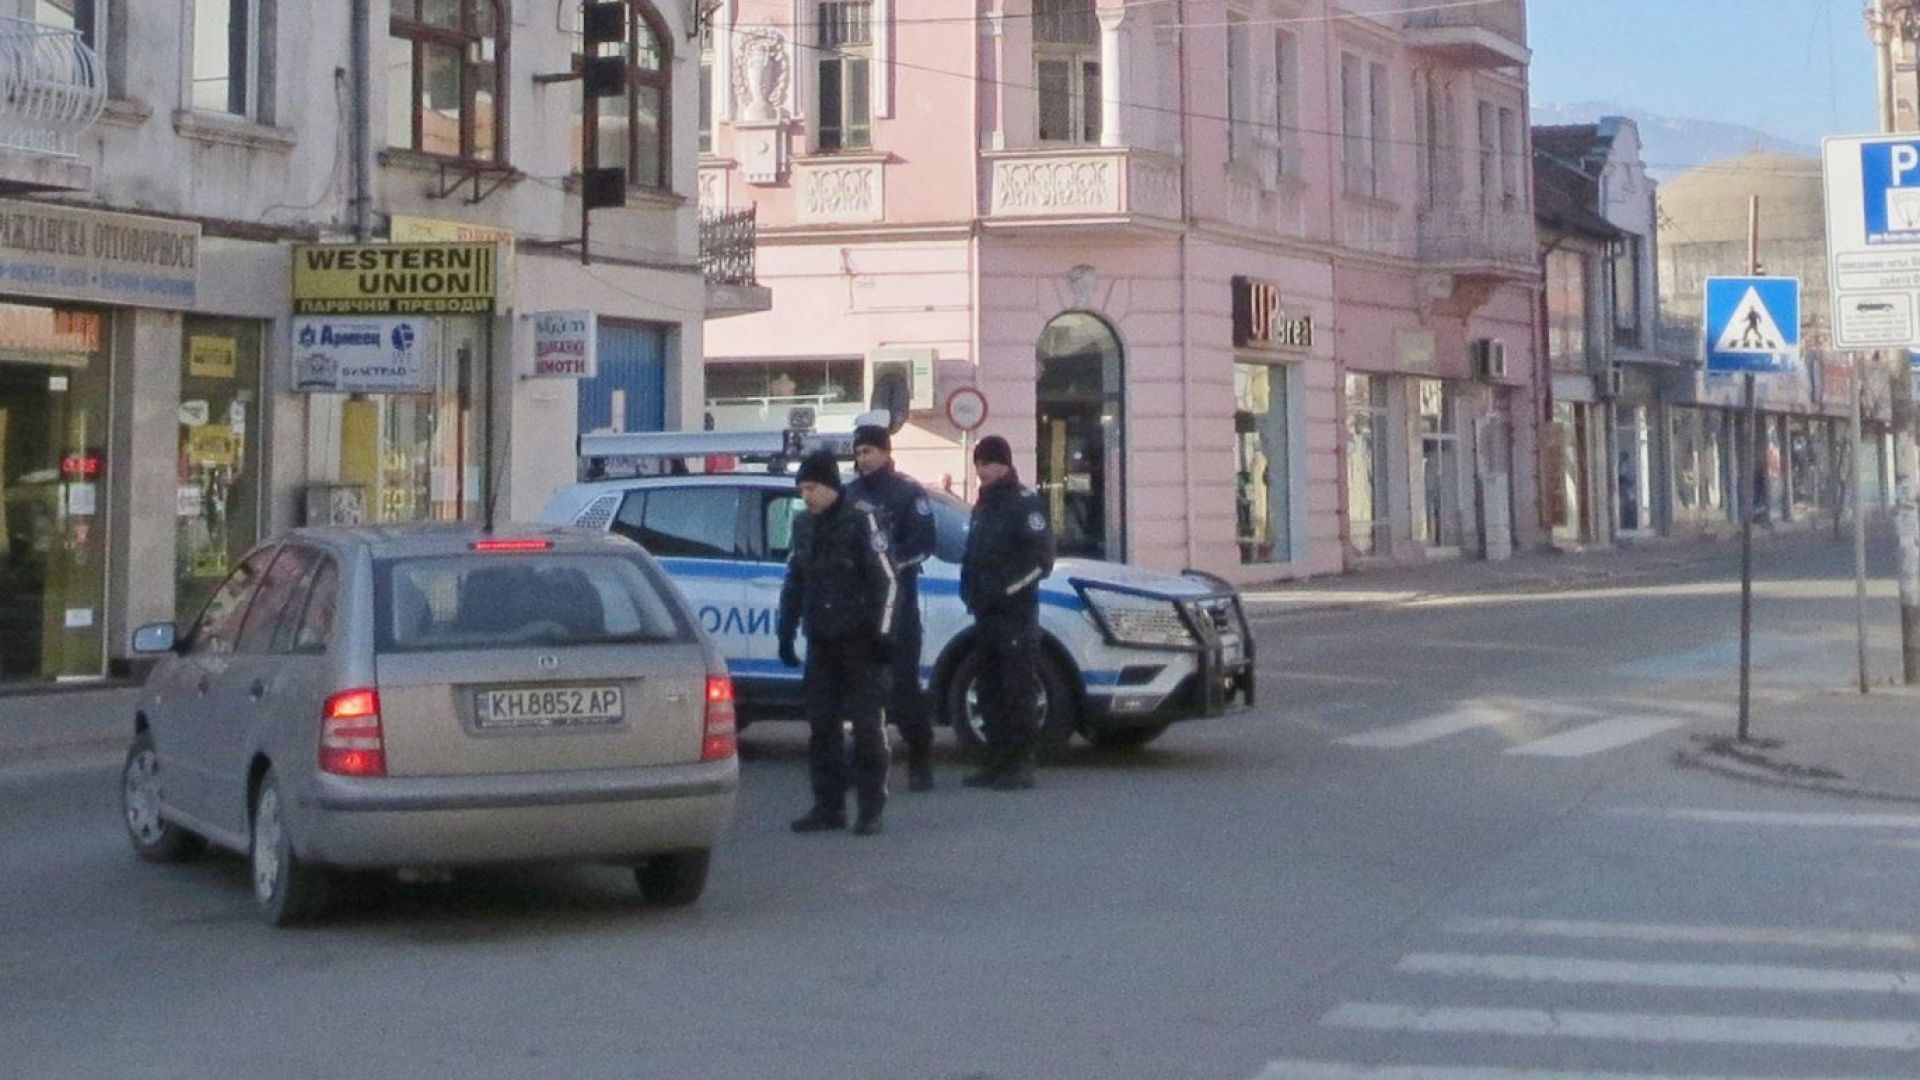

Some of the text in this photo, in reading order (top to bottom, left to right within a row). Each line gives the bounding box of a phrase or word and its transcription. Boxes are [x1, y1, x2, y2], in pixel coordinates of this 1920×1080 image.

[1890, 144, 1918, 186] P
[306, 248, 471, 270] WESTERN
[358, 272, 471, 294] UNION
[300, 298, 490, 313] ПАРИЧНИ ПРЕВОДИ
